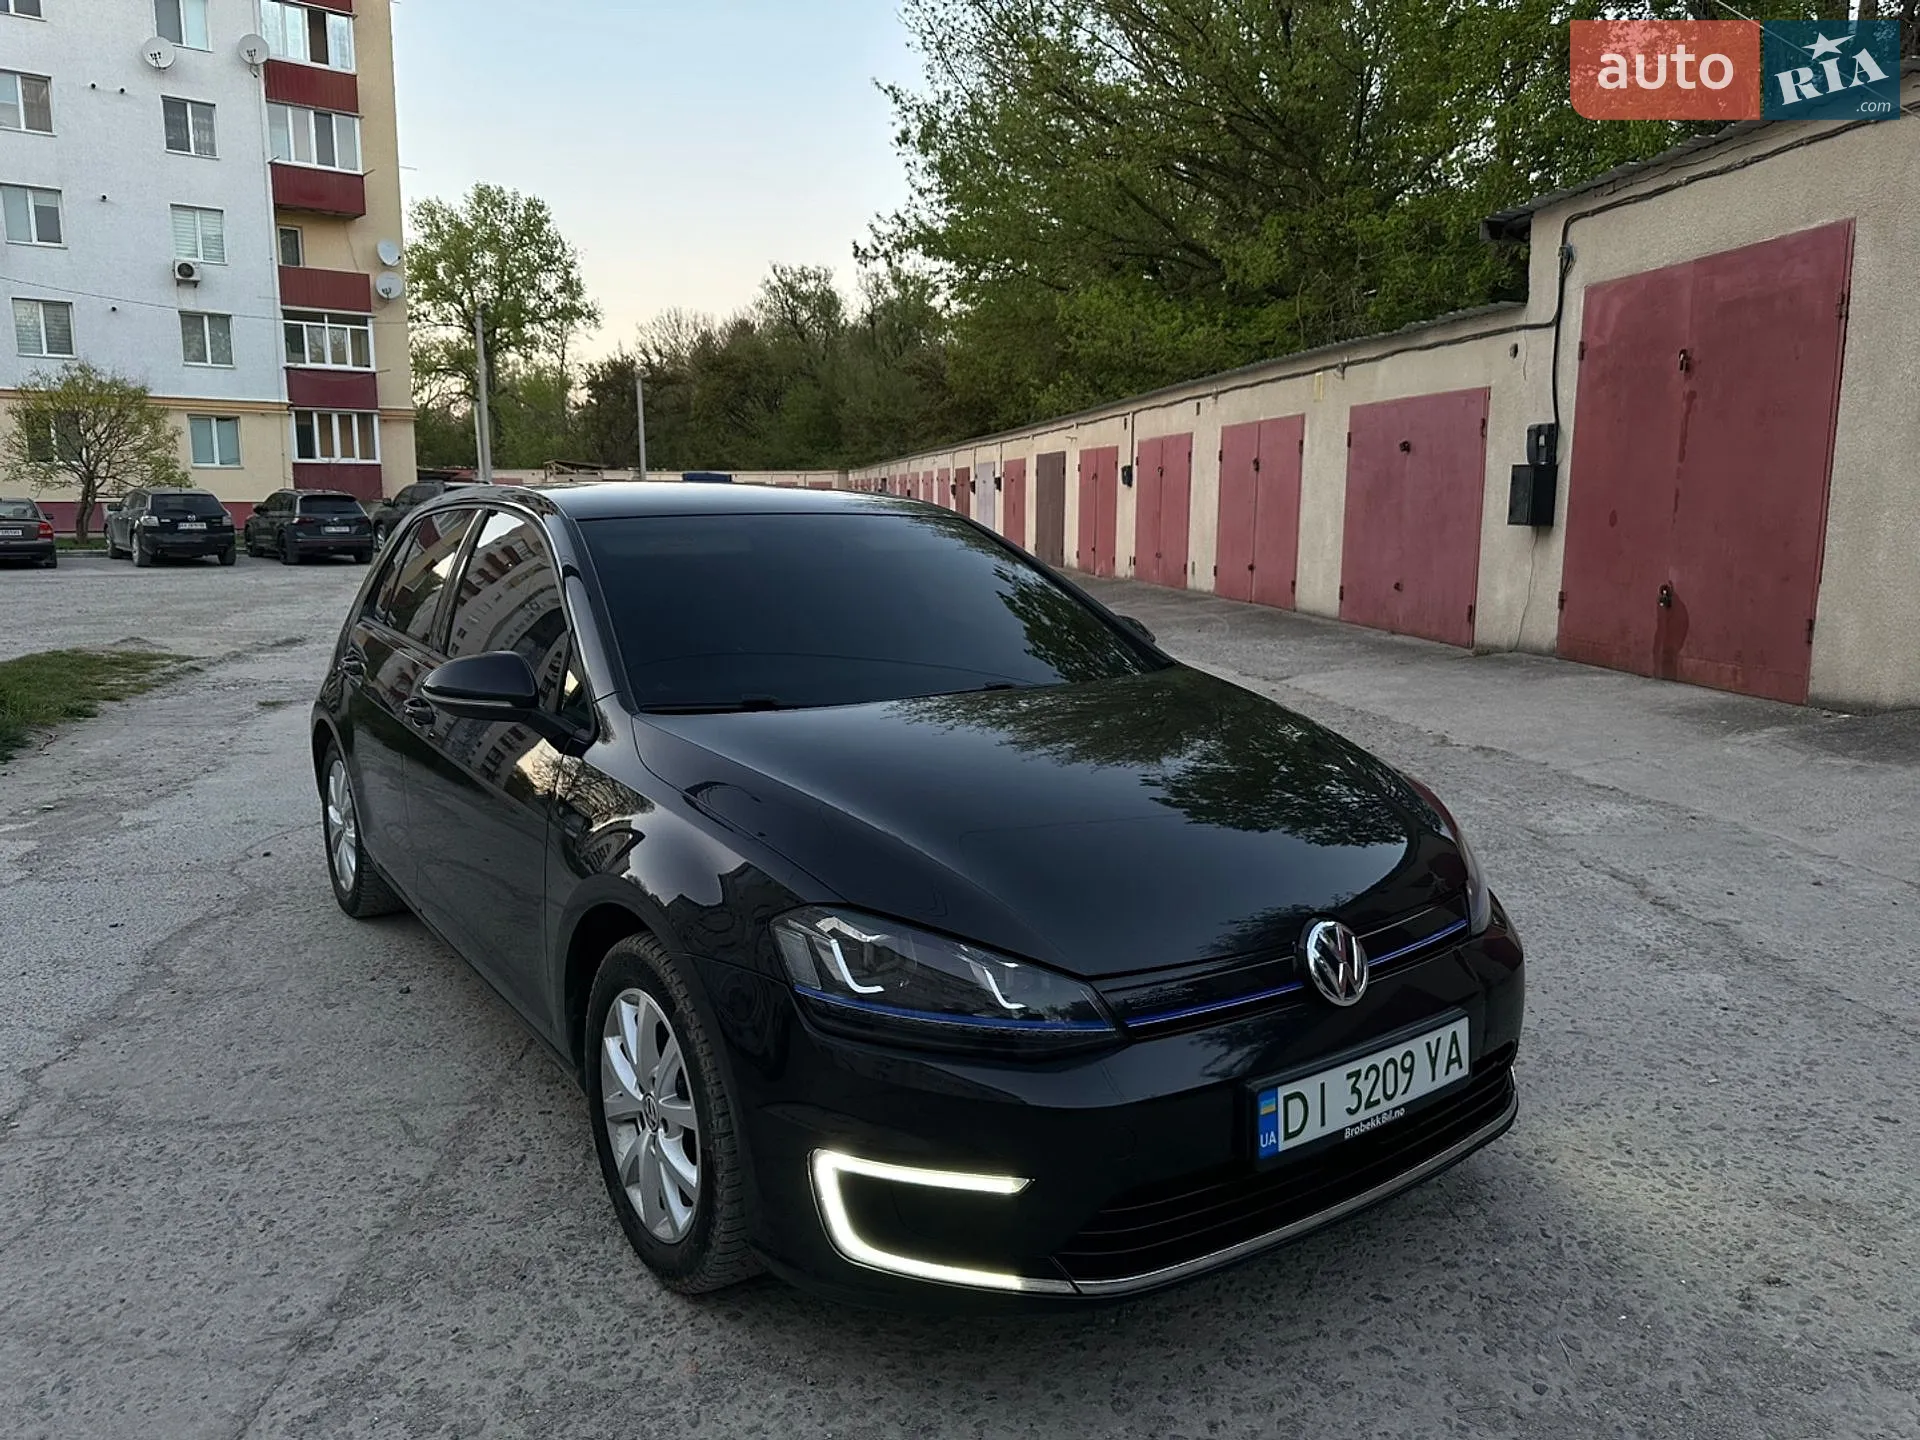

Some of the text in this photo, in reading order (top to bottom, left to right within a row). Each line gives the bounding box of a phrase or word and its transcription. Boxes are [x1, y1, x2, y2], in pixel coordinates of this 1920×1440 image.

[1283, 1030, 1463, 1141] DI 3209 YA
[1260, 1131, 1277, 1148] UA
